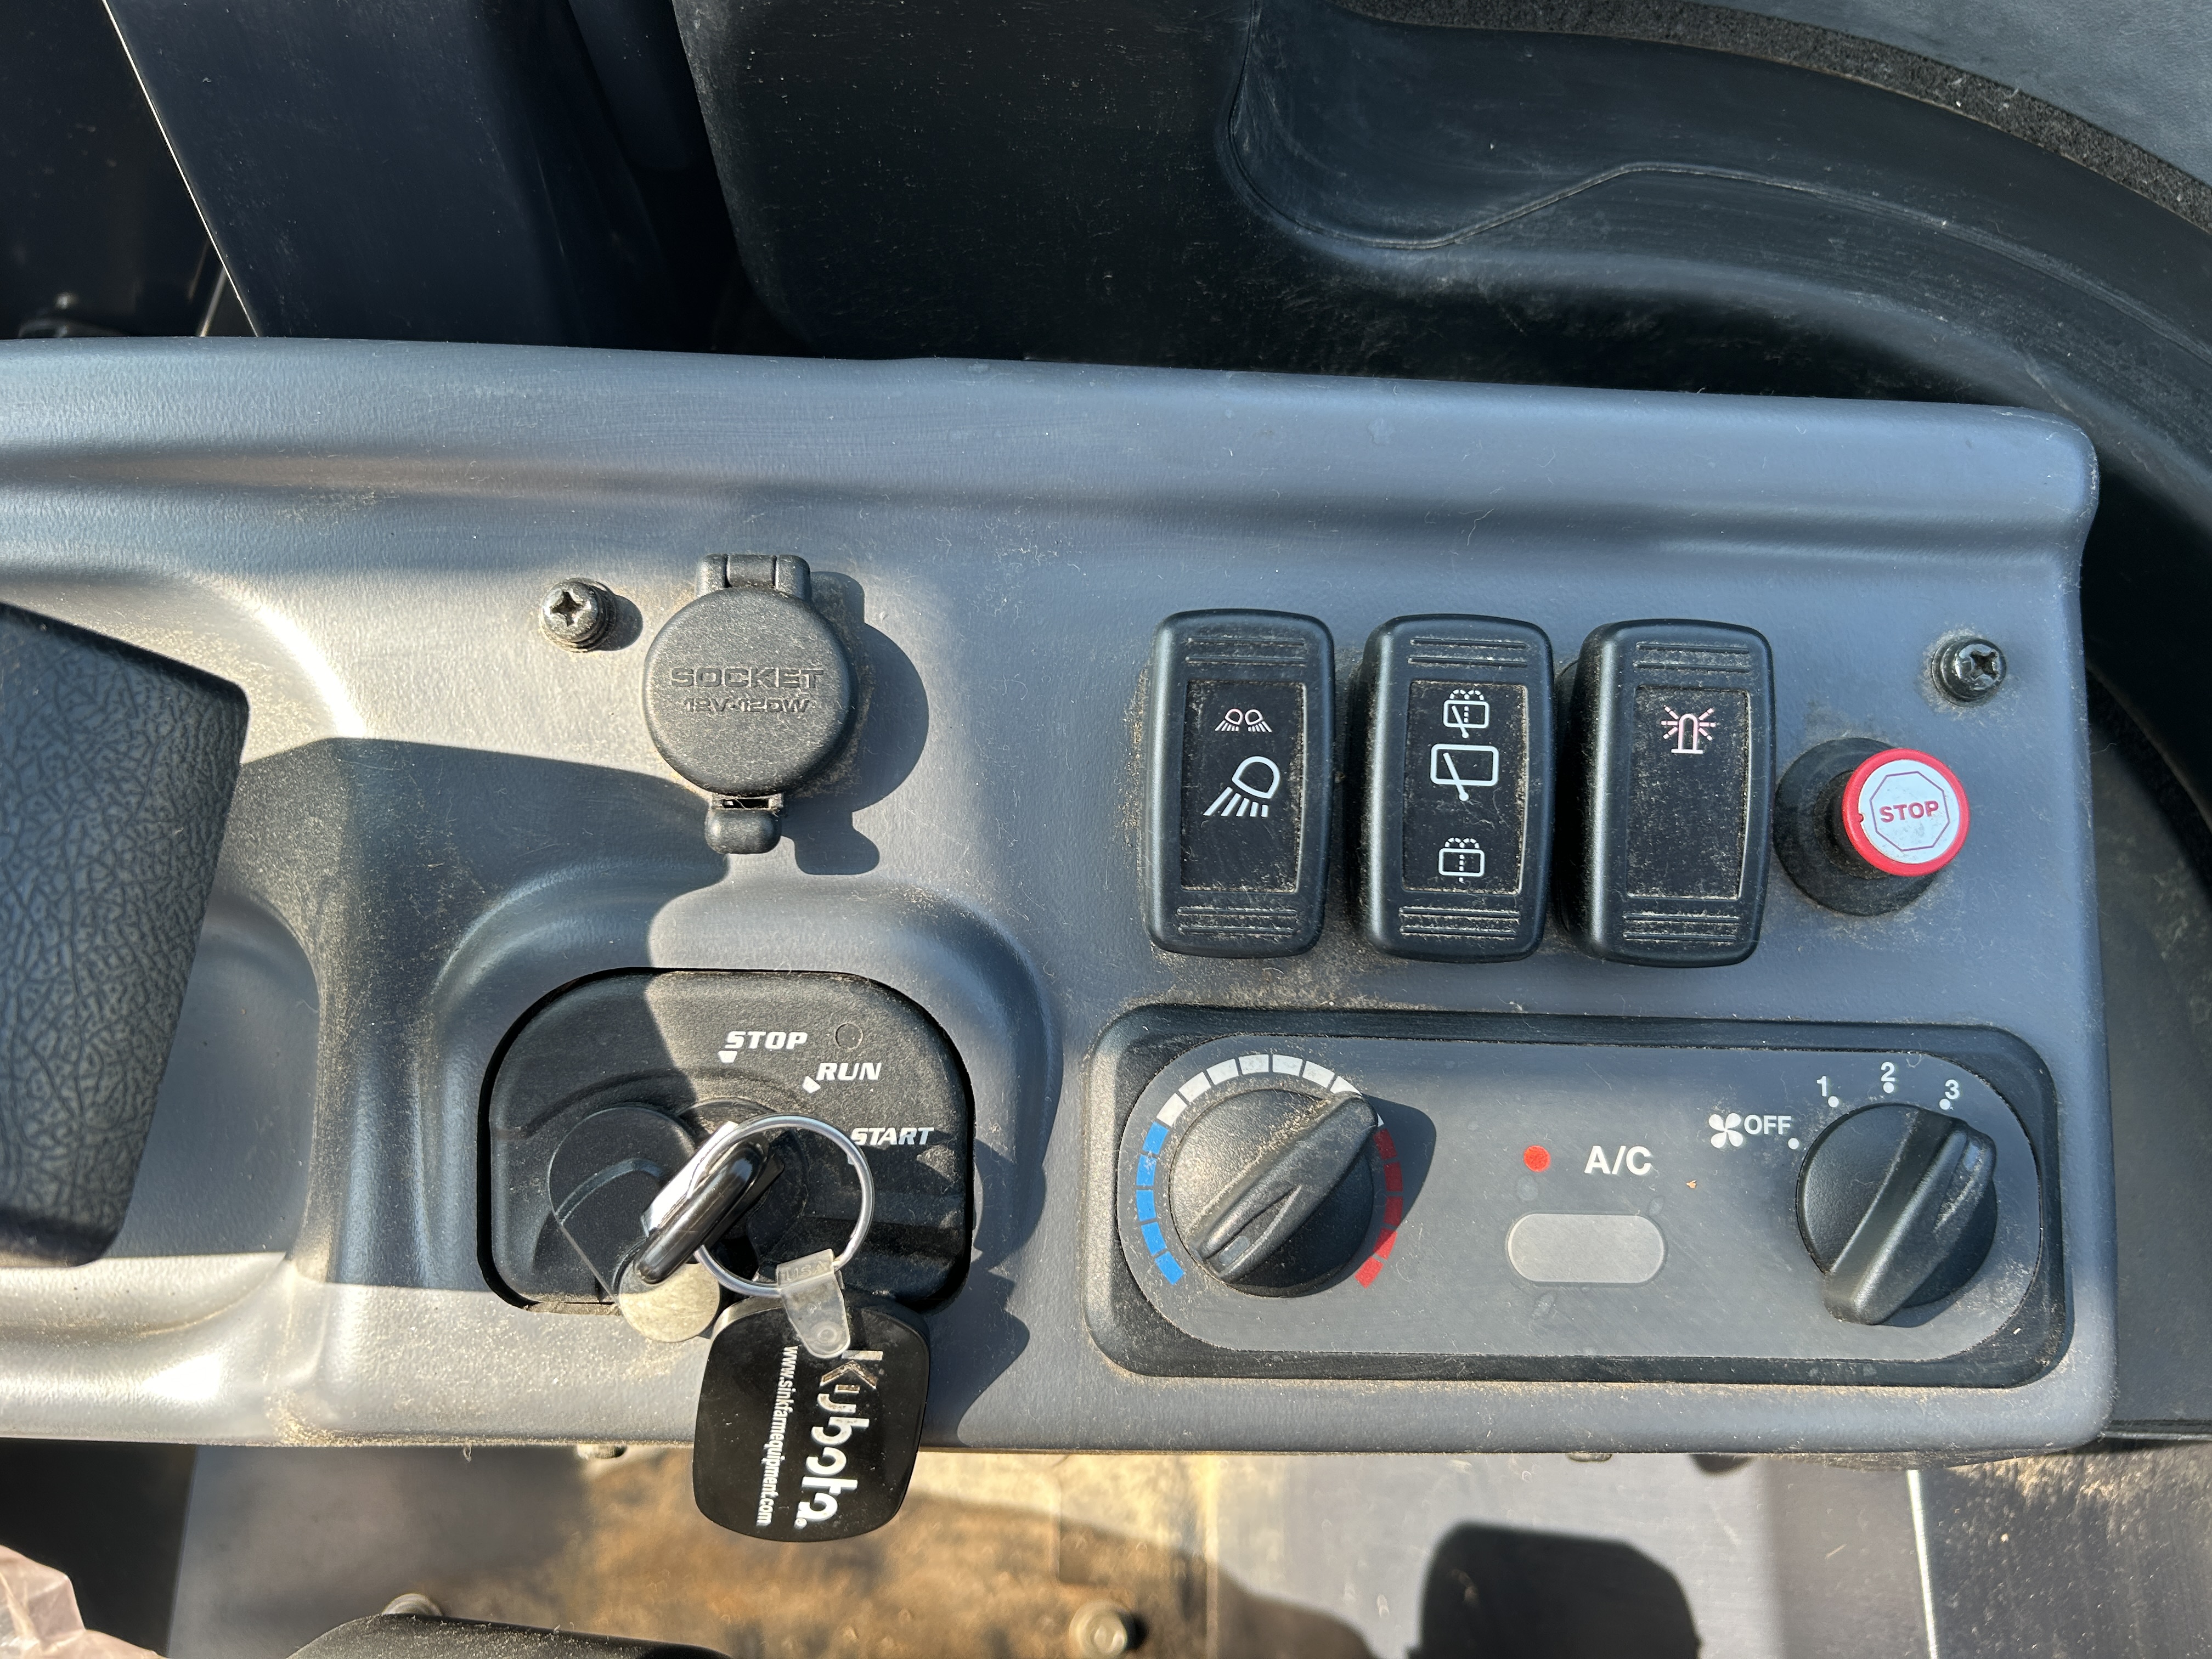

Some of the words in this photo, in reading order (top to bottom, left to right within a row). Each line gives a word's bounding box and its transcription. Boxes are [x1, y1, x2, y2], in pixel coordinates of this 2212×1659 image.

[670, 668, 823, 688] SOCKET
[1878, 800, 1939, 823] STOP
[725, 1031, 808, 1050] STOP
[816, 1062, 882, 1081] RUN
[1881, 1062, 1895, 1082] 2
[1816, 1075, 1829, 1097] 1
[1944, 1079, 1961, 1100] 3
[1743, 1115, 1792, 1135] OFF
[850, 1127, 934, 1146] START
[1584, 1145, 1652, 1176] A/C
[756, 1345, 799, 1527] www.sinkfarmequipment.com
